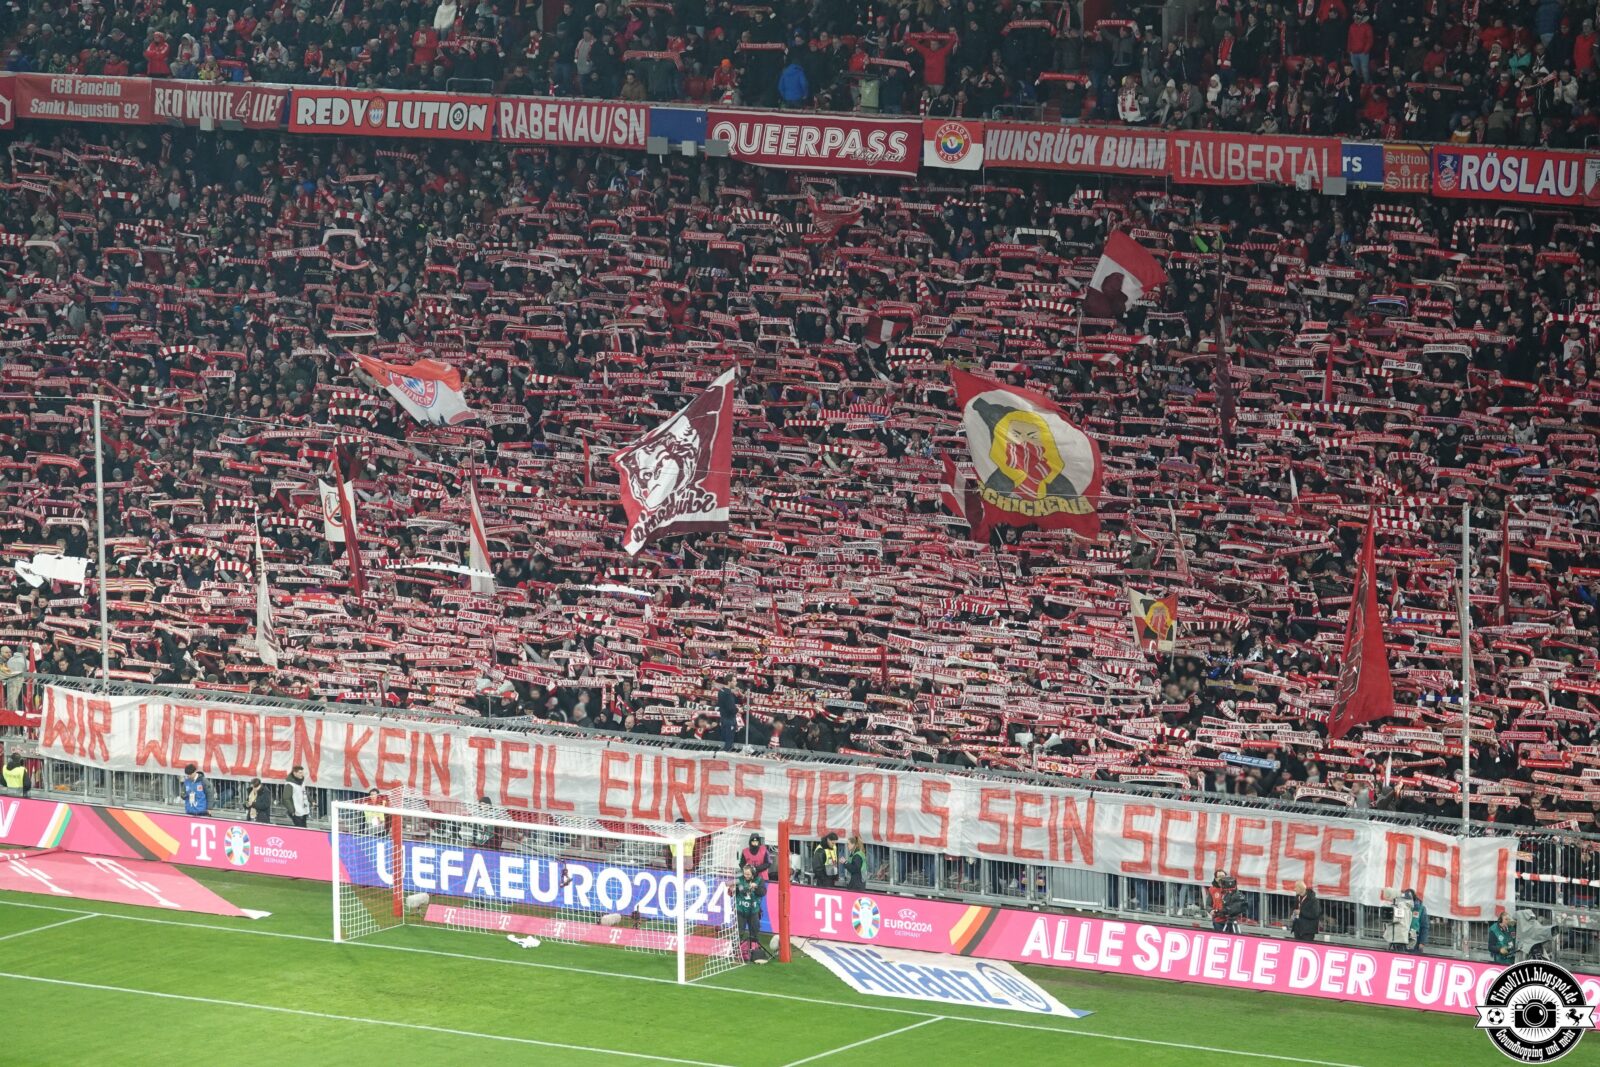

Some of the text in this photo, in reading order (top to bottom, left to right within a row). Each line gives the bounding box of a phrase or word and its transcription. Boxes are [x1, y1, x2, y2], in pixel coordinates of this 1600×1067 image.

[31, 98, 65, 114] Sankt
[51, 79, 121, 97] FCB Fanclub
[154, 87, 183, 117] RED
[186, 90, 234, 120] WHITE
[500, 101, 646, 145] RABENAU/SN
[712, 121, 909, 158] QUEERPASS
[937, 124, 969, 140] SEKTION
[985, 128, 1167, 170] HUNSRÜCK BUAM
[1460, 152, 1579, 197] RÖSLAU
[42, 685, 112, 762] WIR
[136, 703, 323, 783] WERDEN
[343, 722, 451, 797] KEIN
[468, 736, 576, 811] TEIL
[598, 750, 765, 832] EURES
[786, 768, 951, 848] DEALS
[977, 788, 1096, 866] SEIN
[1121, 803, 1355, 896] SCHEISS
[884, 919, 933, 935] EURO2024
[813, 942, 1012, 1005] Allianz
[1021, 916, 1125, 967] ALLE
[1131, 924, 1279, 985] SPIELE
[1287, 947, 1377, 998] DER
